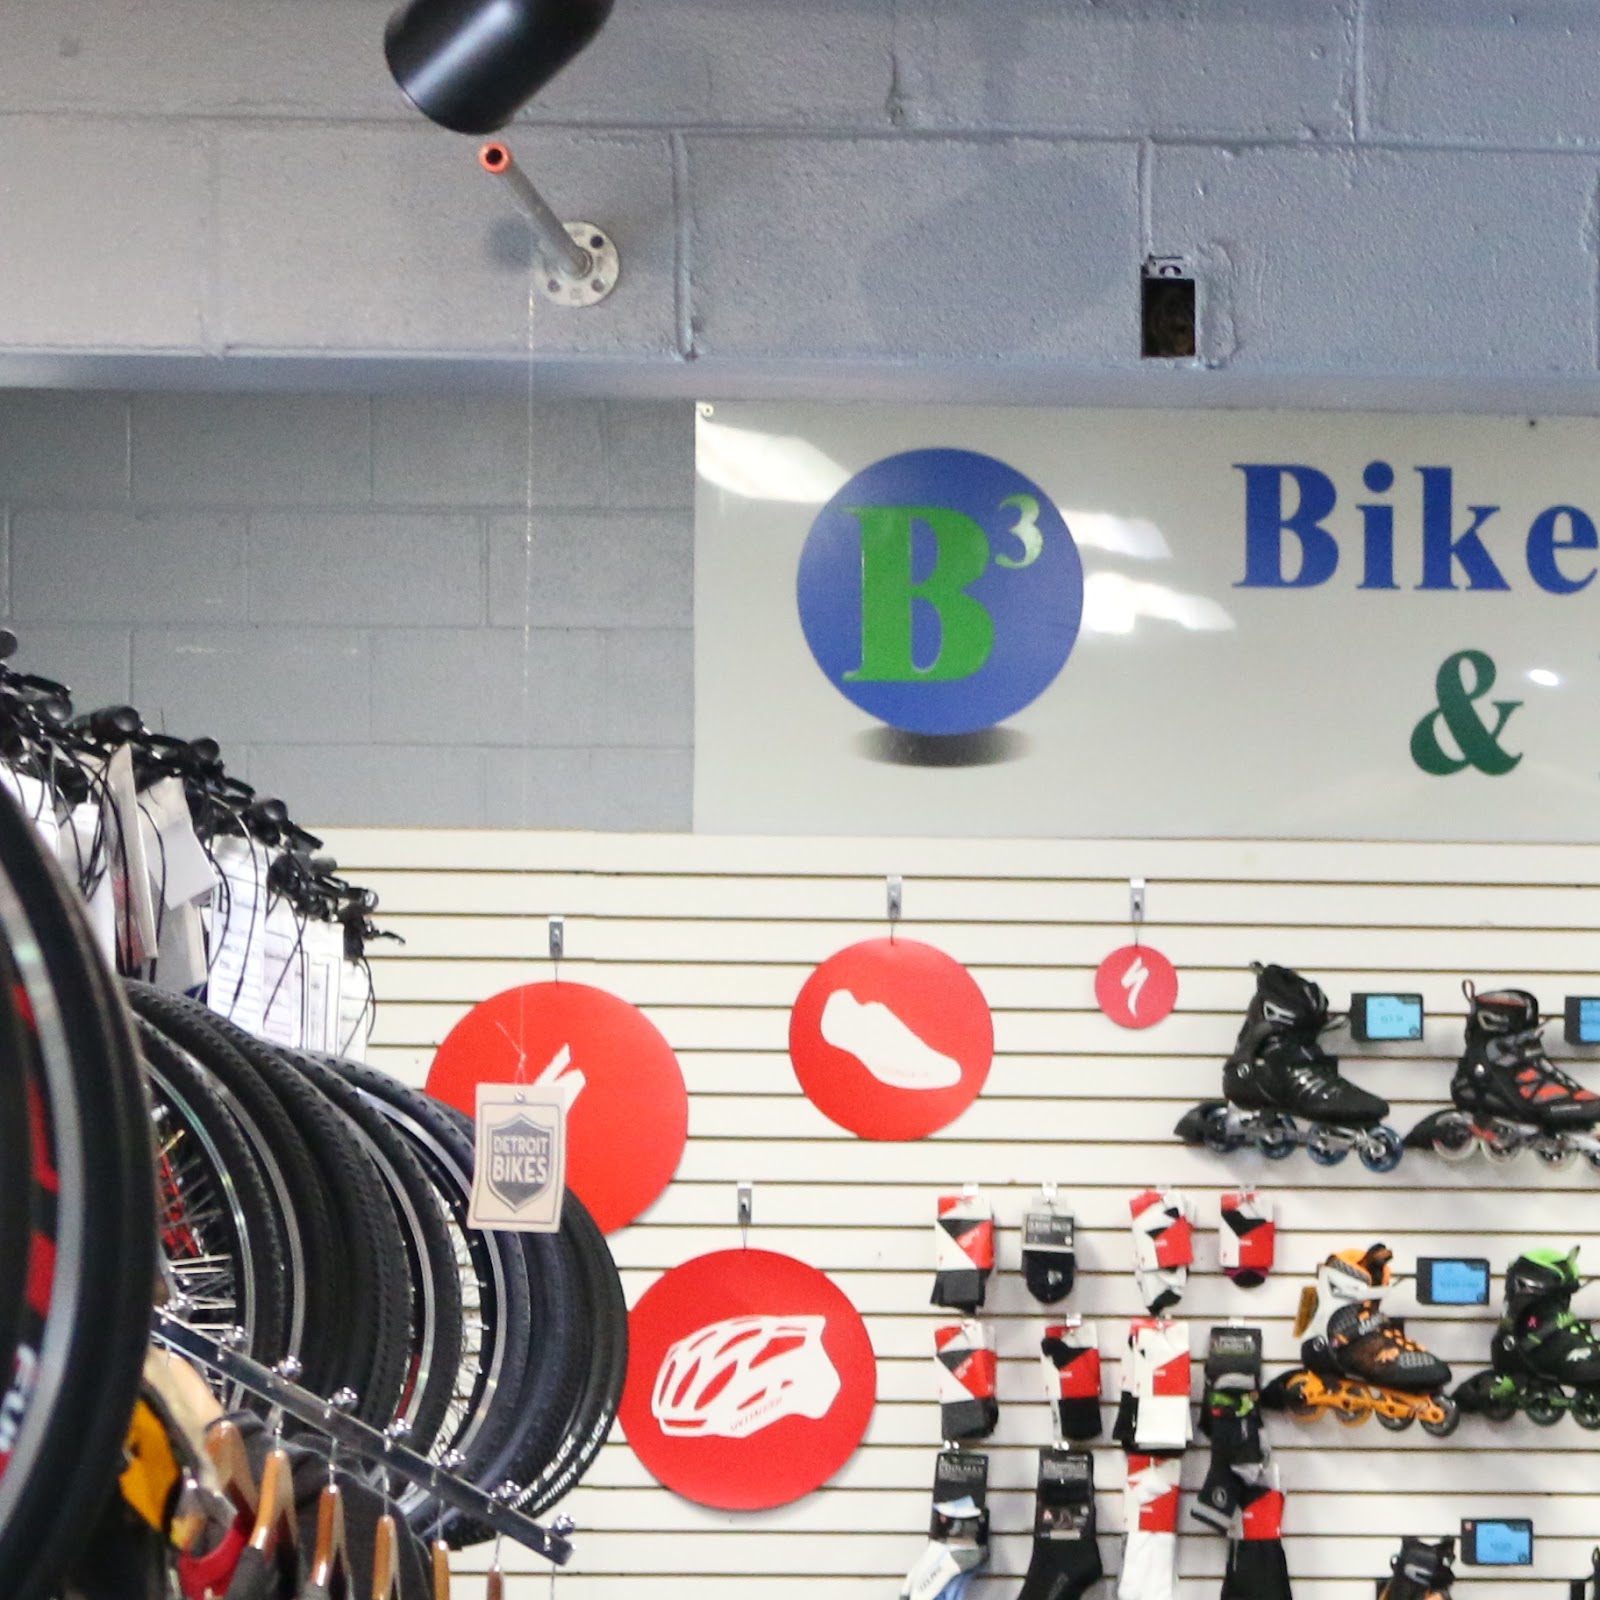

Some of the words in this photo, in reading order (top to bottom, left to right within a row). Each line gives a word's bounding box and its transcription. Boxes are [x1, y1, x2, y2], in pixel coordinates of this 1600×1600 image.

[1410, 648, 1523, 779] &
[492, 1134, 549, 1155] DETROIT
[491, 1155, 548, 1184] BIKES
